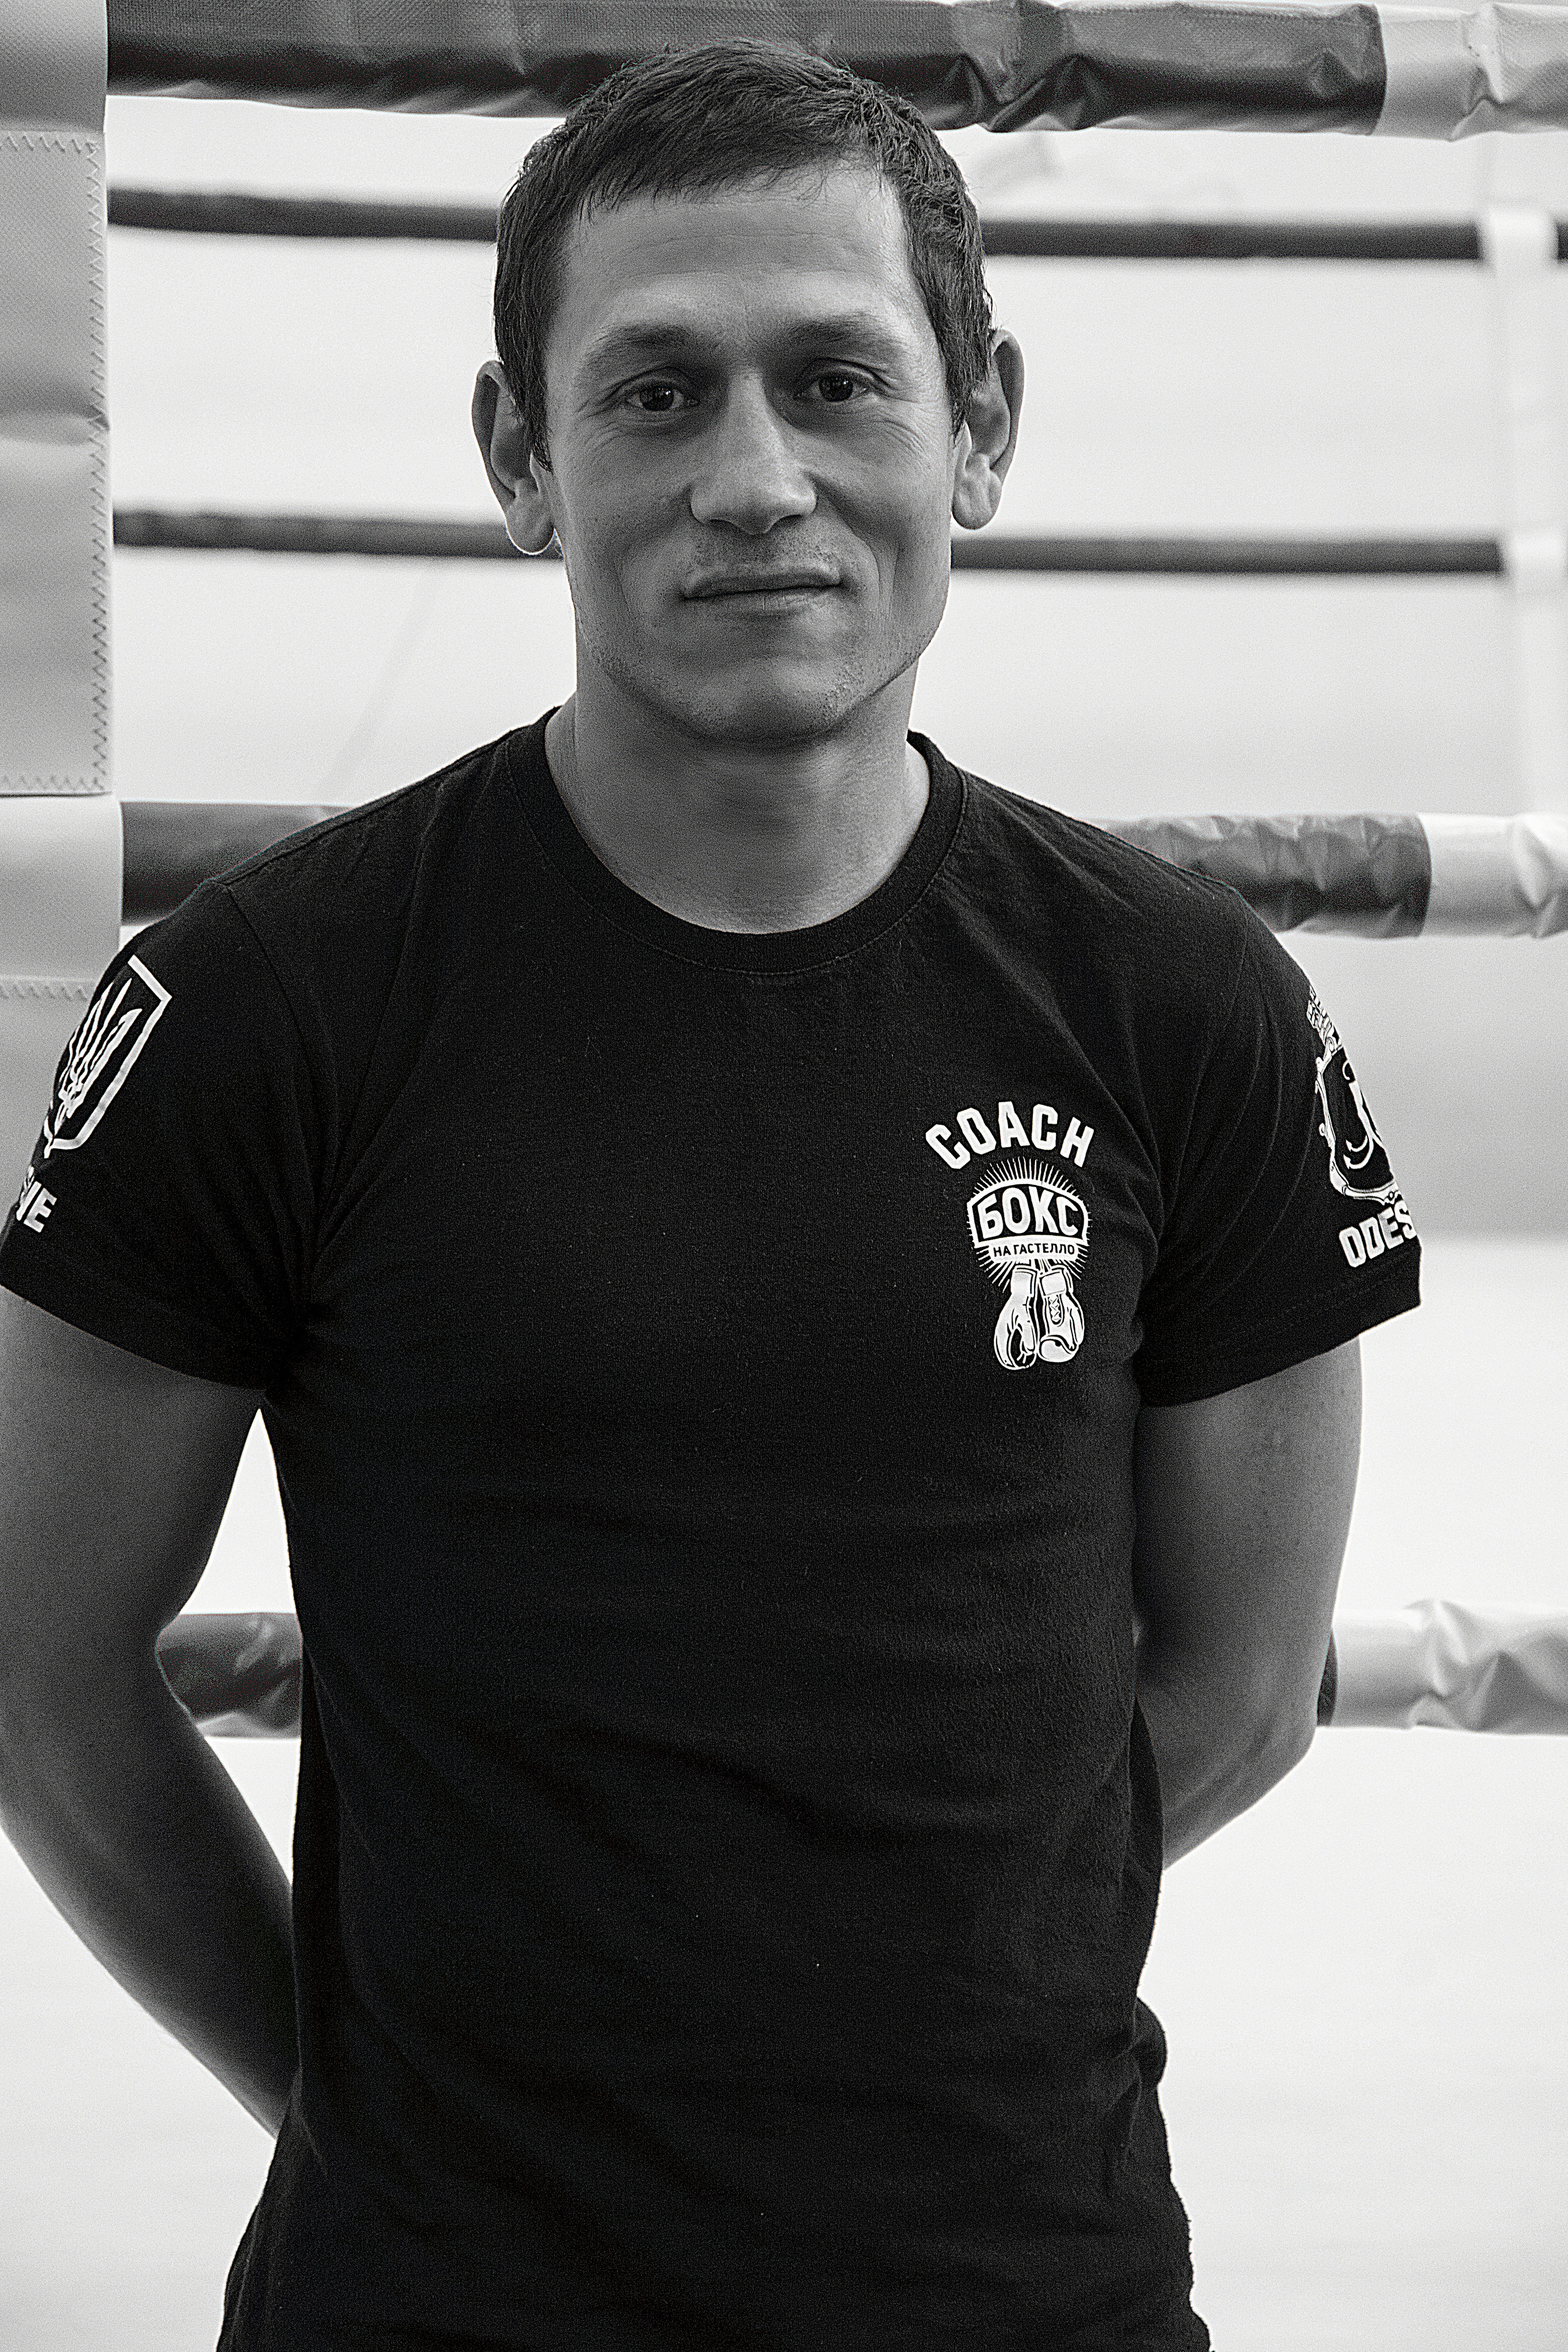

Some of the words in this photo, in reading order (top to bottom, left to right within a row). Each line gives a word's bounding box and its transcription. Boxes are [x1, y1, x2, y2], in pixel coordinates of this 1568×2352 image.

[925, 1101, 1095, 1169] COACH
[977, 1186, 1079, 1239] БОКС
[1338, 1200, 1417, 1268] ODES
[993, 1245, 1012, 1257] НА
[1013, 1243, 1076, 1255] ГАСТЕЛЛО
